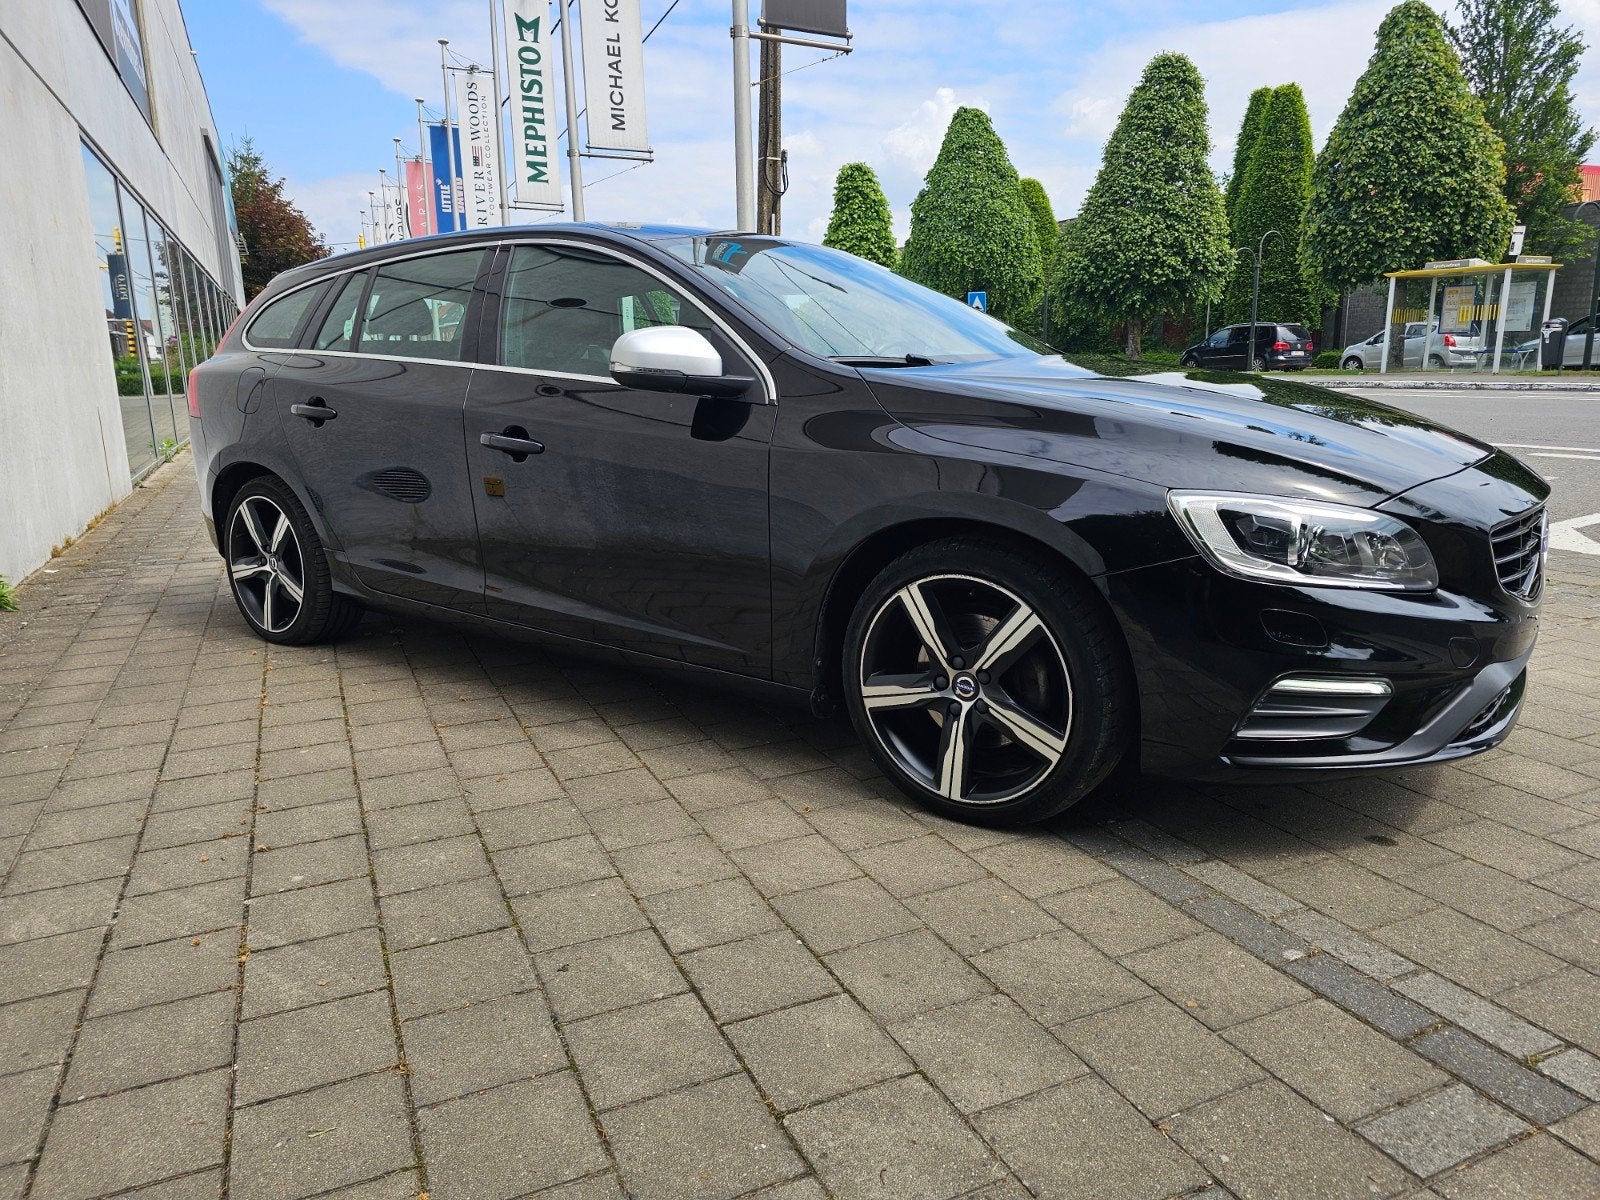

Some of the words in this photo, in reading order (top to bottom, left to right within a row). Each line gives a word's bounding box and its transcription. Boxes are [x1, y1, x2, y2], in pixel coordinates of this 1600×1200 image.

[467, 82, 481, 142] WOODS
[606, 33, 626, 131] MICHAEL
[480, 95, 491, 159] COLLECTION
[517, 46, 549, 183] MEPHISTO
[440, 184, 451, 213] LITTLE
[474, 171, 488, 226] RIVER
[487, 163, 495, 217] FOOTWEAR
